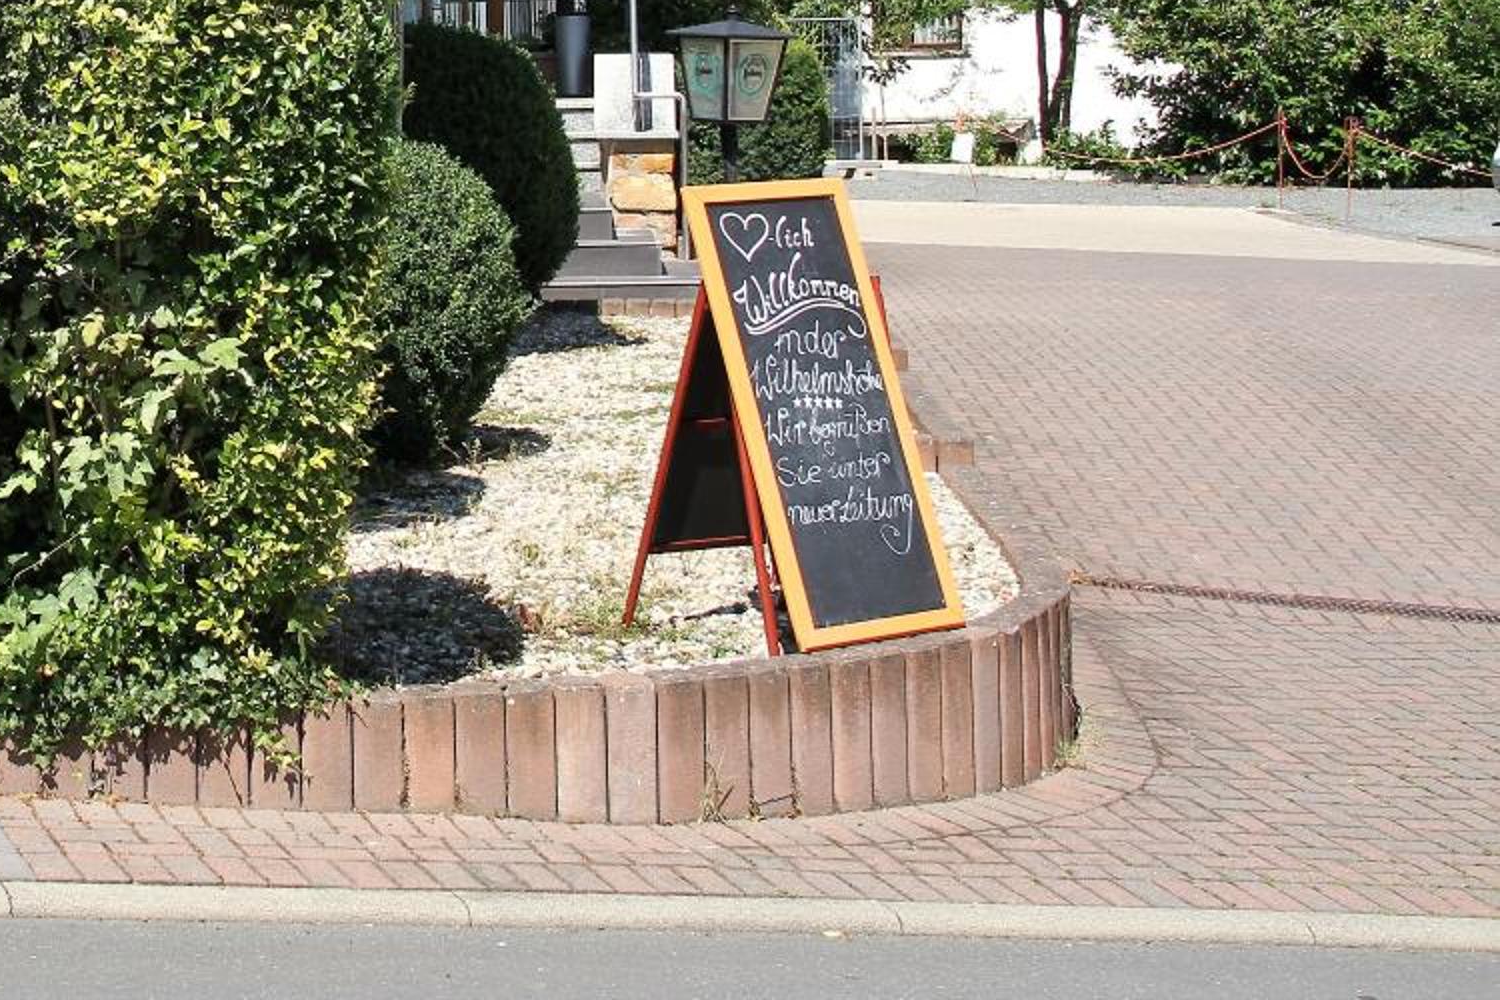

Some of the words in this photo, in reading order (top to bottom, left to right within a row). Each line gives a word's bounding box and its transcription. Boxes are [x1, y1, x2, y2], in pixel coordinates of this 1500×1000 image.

[733, 252, 861, 325] Willkommen
[765, 407, 807, 447] Wir
[776, 457, 822, 487] Sie
[828, 451, 891, 480] unter
